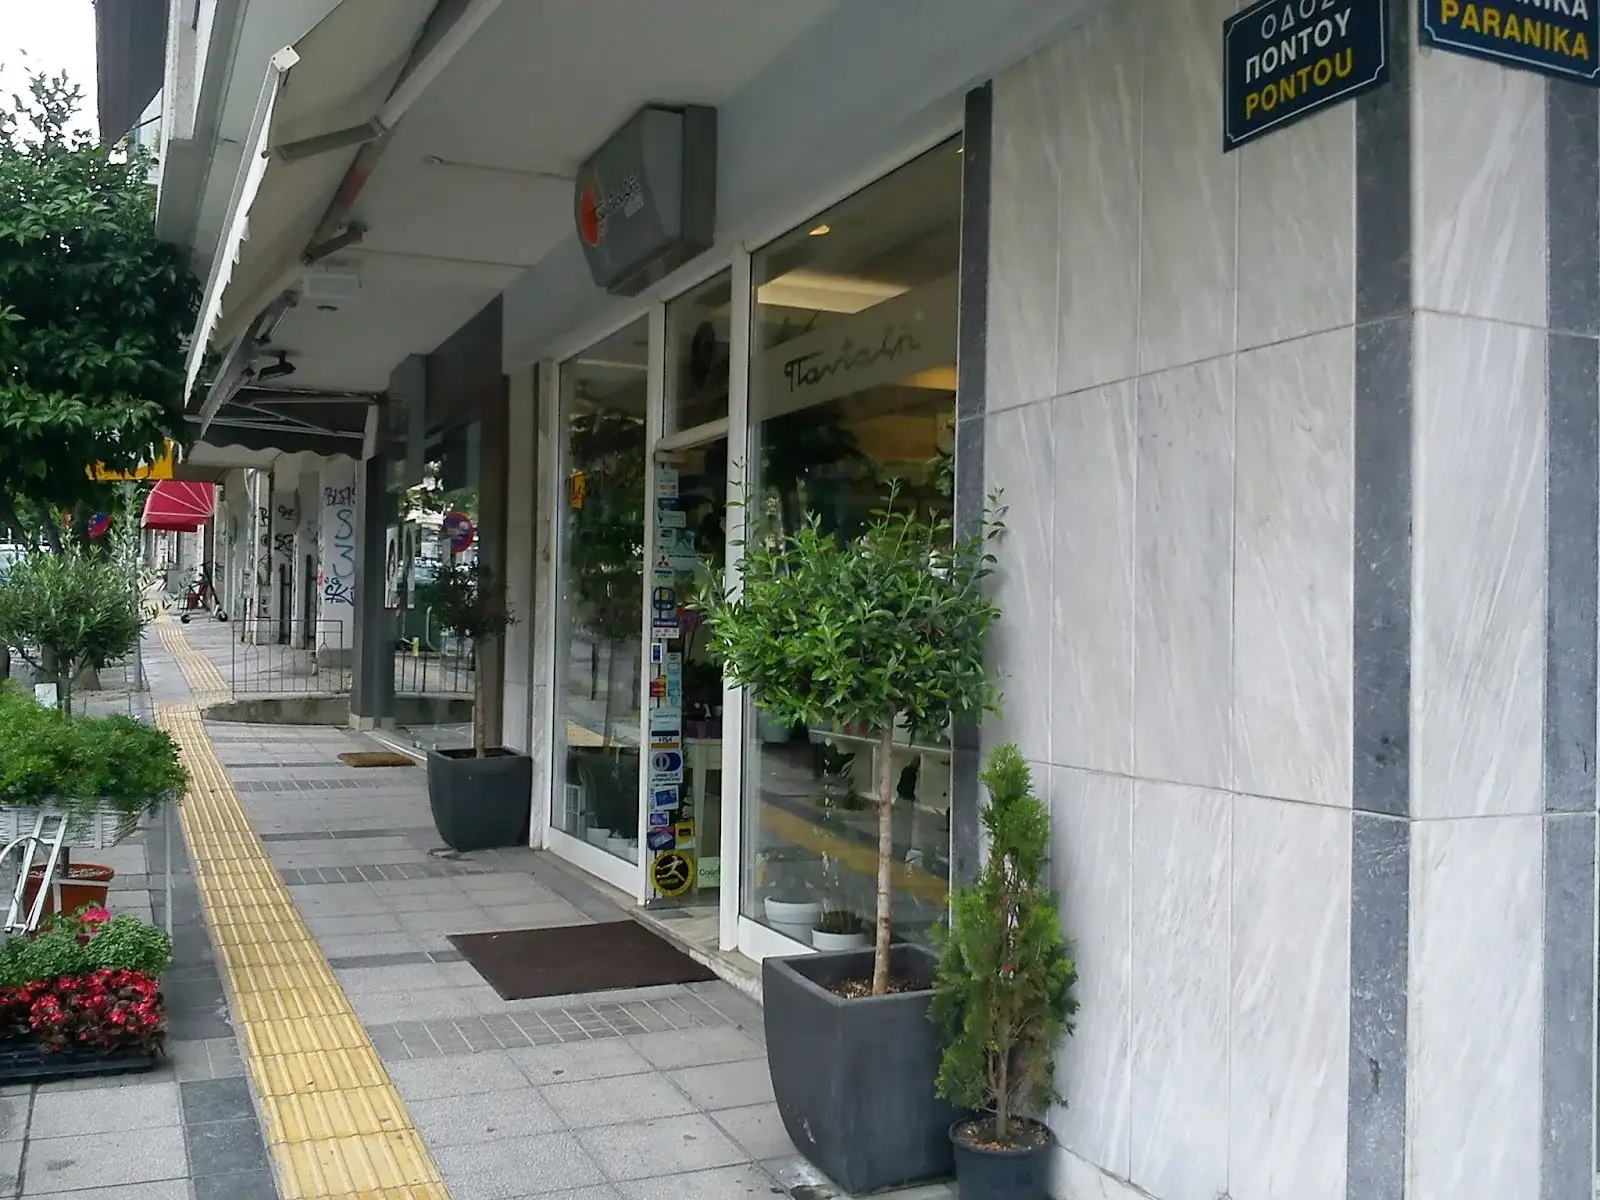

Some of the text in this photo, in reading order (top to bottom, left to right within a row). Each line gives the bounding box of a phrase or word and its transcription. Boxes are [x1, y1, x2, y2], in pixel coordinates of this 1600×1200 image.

[1245, 7, 1352, 84] ΠΟΝΤΟΥ
[1440, 0, 1590, 61] PARANIKA
[1245, 47, 1353, 120] PONTOU
